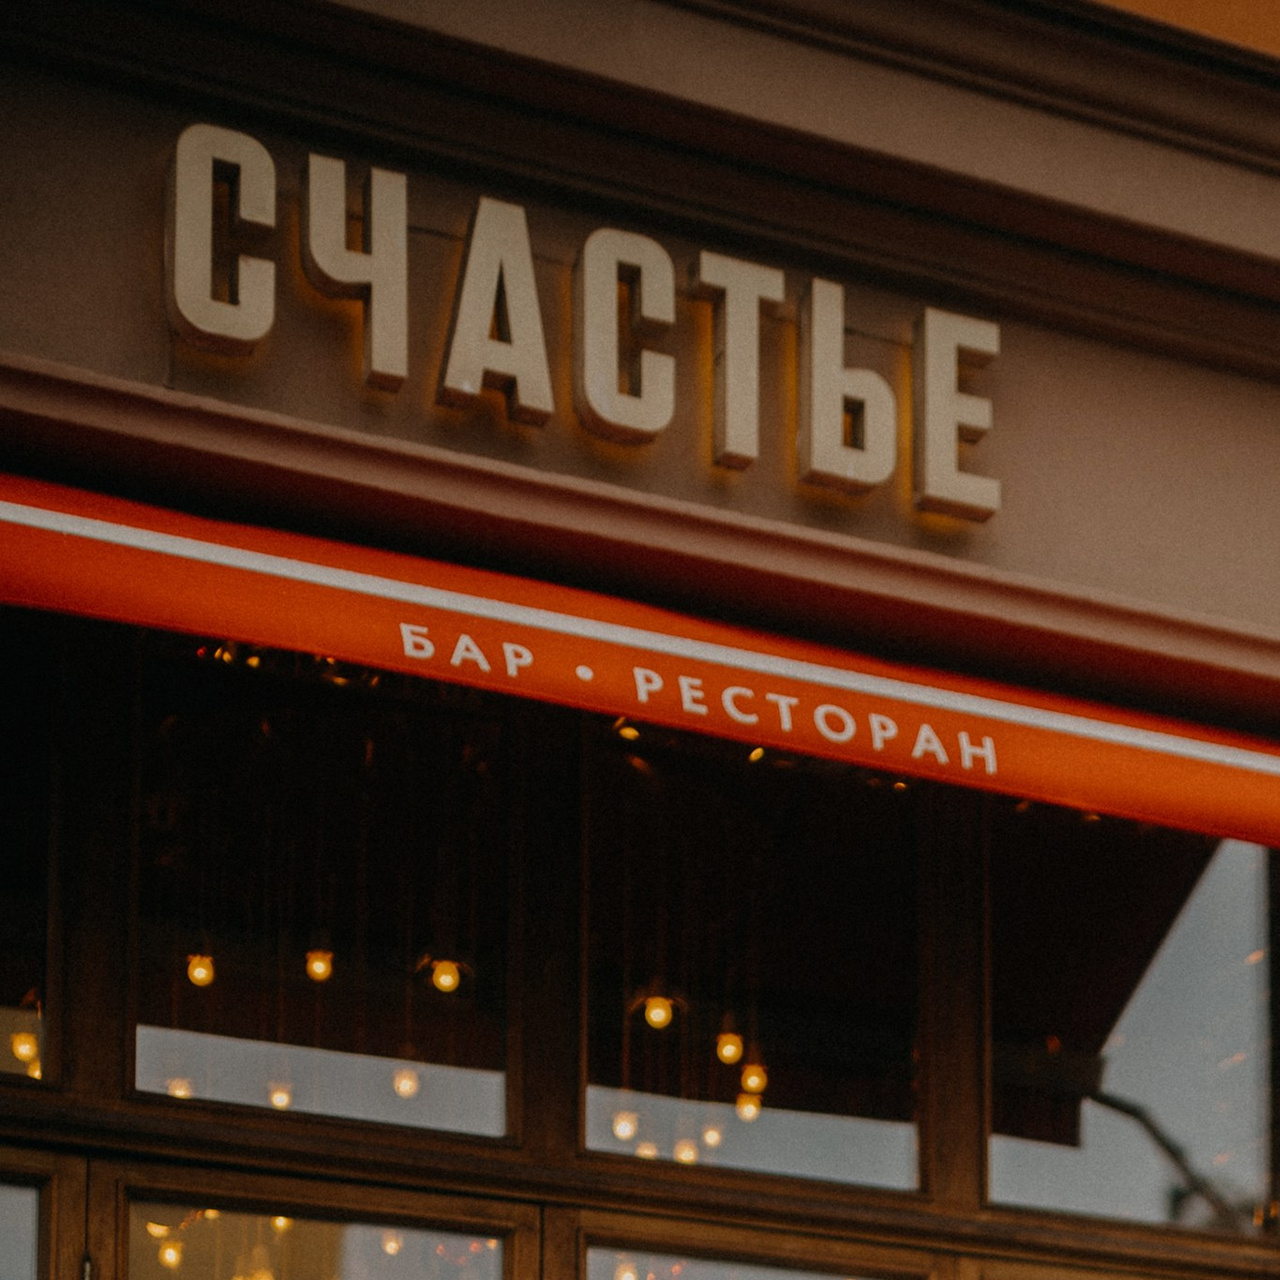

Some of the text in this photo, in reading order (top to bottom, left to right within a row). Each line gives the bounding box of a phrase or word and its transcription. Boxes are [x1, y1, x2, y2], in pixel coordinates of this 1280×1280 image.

[172, 122, 999, 518] СЧАСТЬЕ
[400, 622, 998, 775] БАР РЕСТОРАН
